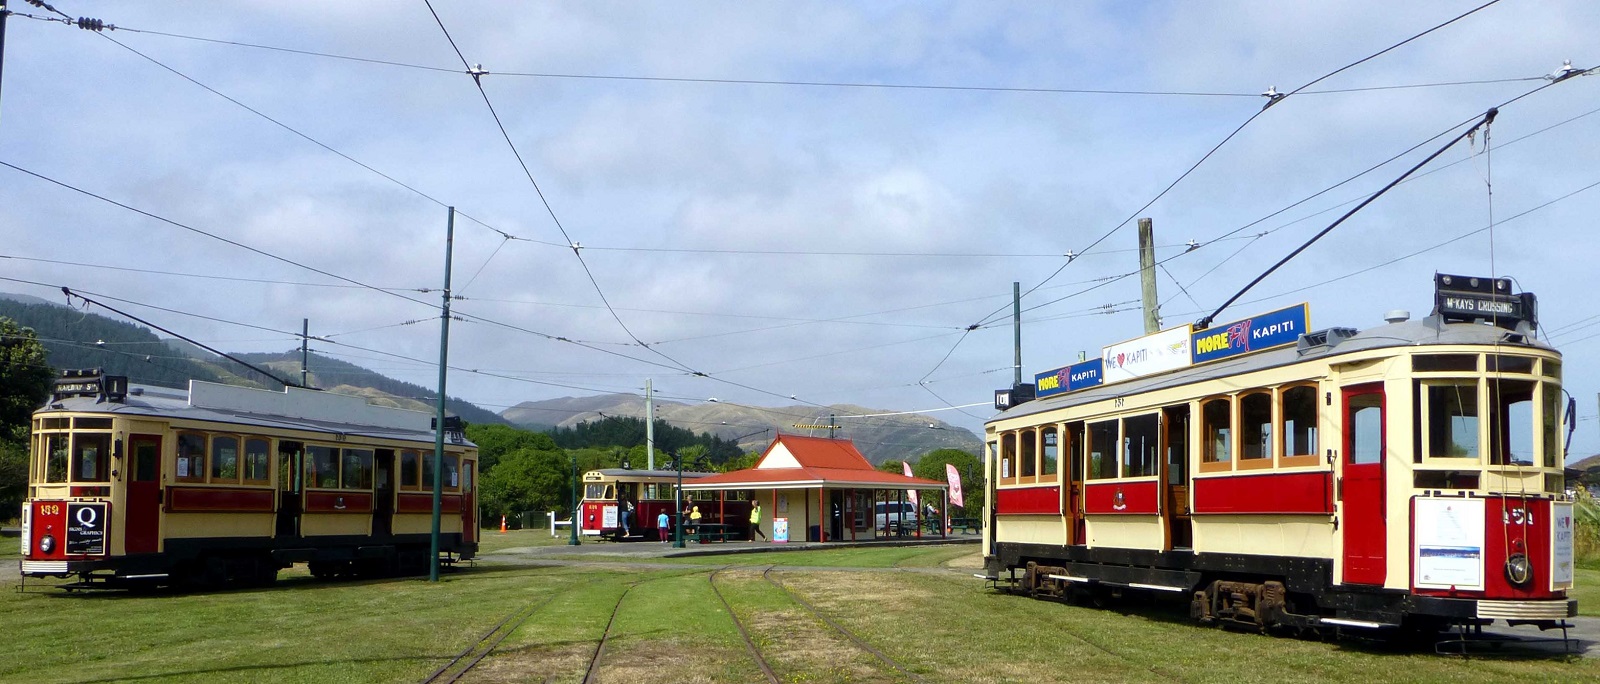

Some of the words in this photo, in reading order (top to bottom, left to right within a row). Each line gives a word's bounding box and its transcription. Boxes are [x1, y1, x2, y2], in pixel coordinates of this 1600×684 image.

[1478, 300, 1513, 313] CROSSING
[1197, 332, 1229, 354] MORE
[1253, 320, 1294, 339] KAPITI
[1126, 348, 1148, 366] KAPITI
[1038, 375, 1058, 390] MORE
[1071, 369, 1097, 382] KAPITI
[76, 507, 97, 527] Q
[1503, 507, 1533, 525] 151
